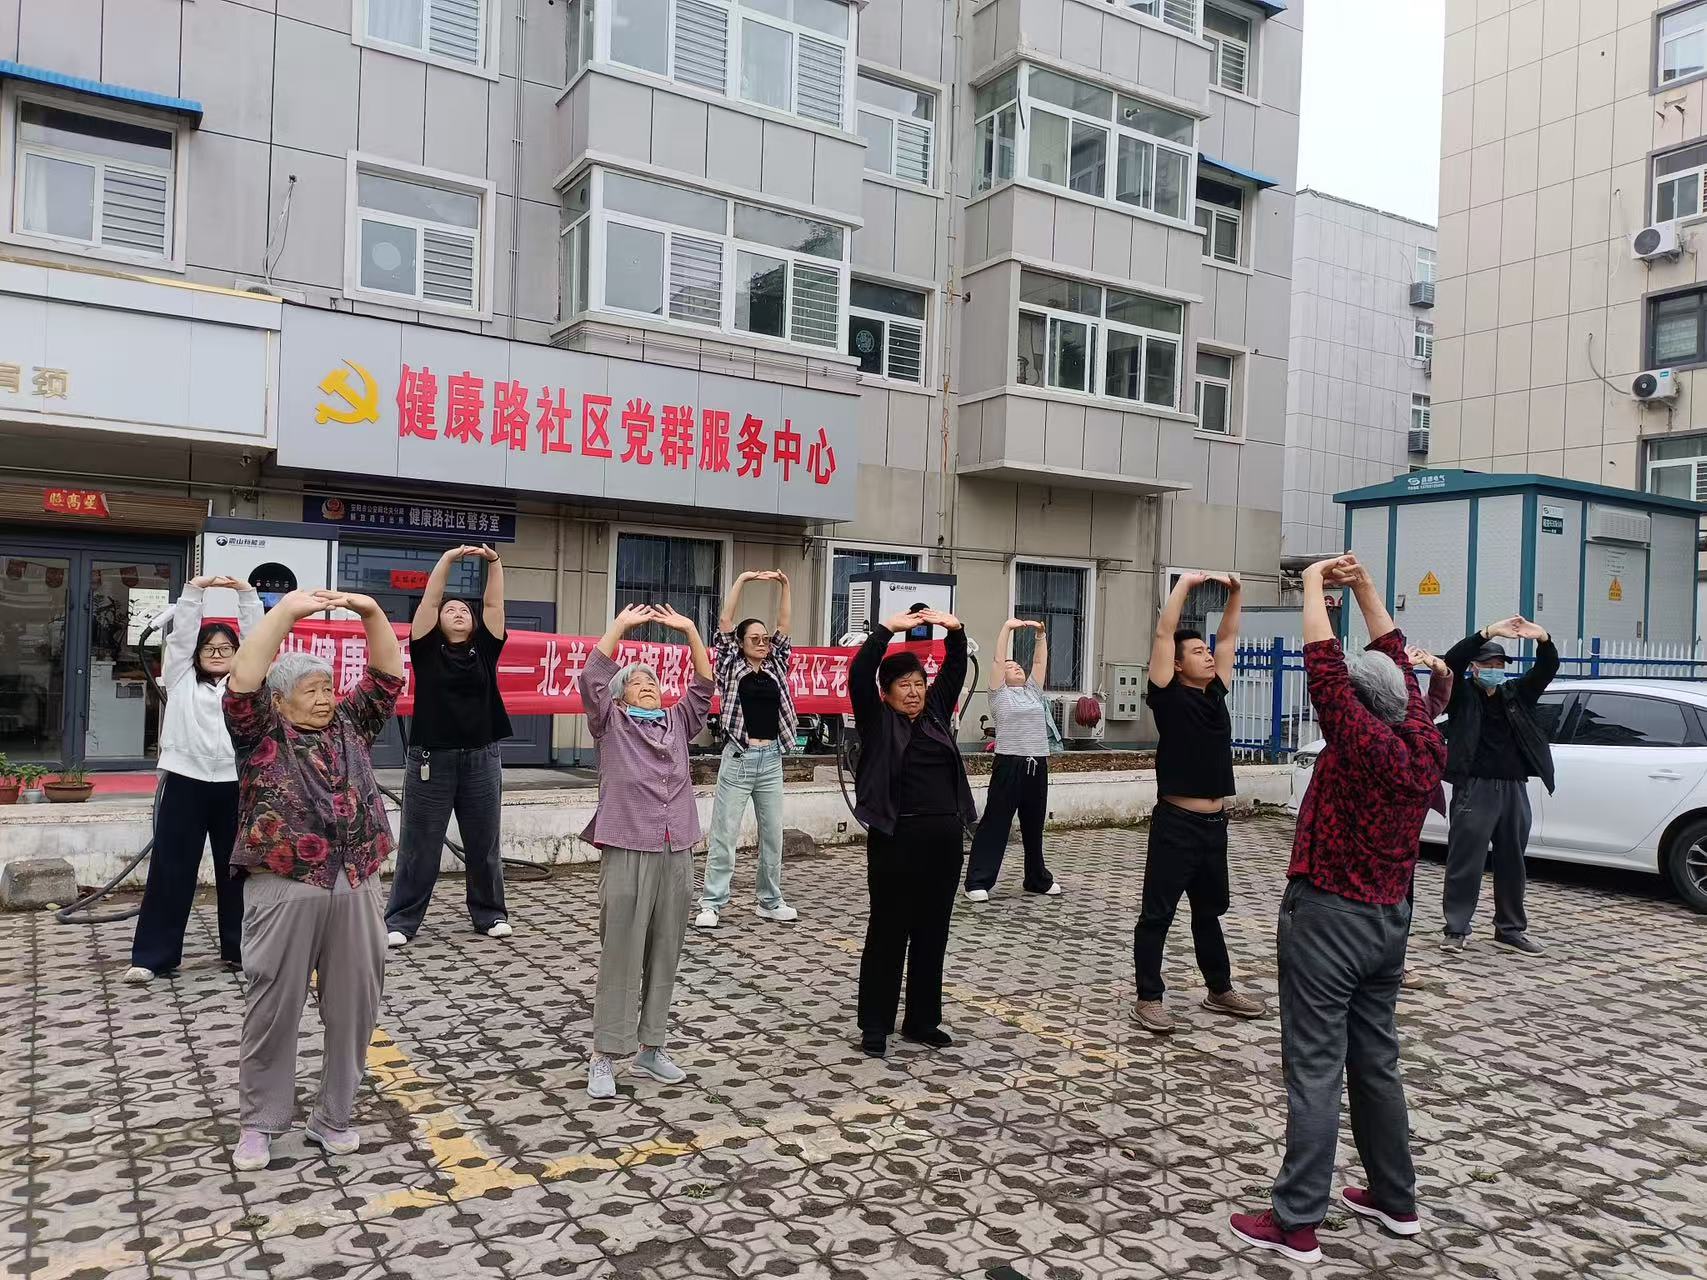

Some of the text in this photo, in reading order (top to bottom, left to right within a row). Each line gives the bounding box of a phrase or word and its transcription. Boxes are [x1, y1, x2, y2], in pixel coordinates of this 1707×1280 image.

[396, 363, 836, 485] 健康路社区党群服务中心
[409, 507, 500, 532] 健康路社区警务室
